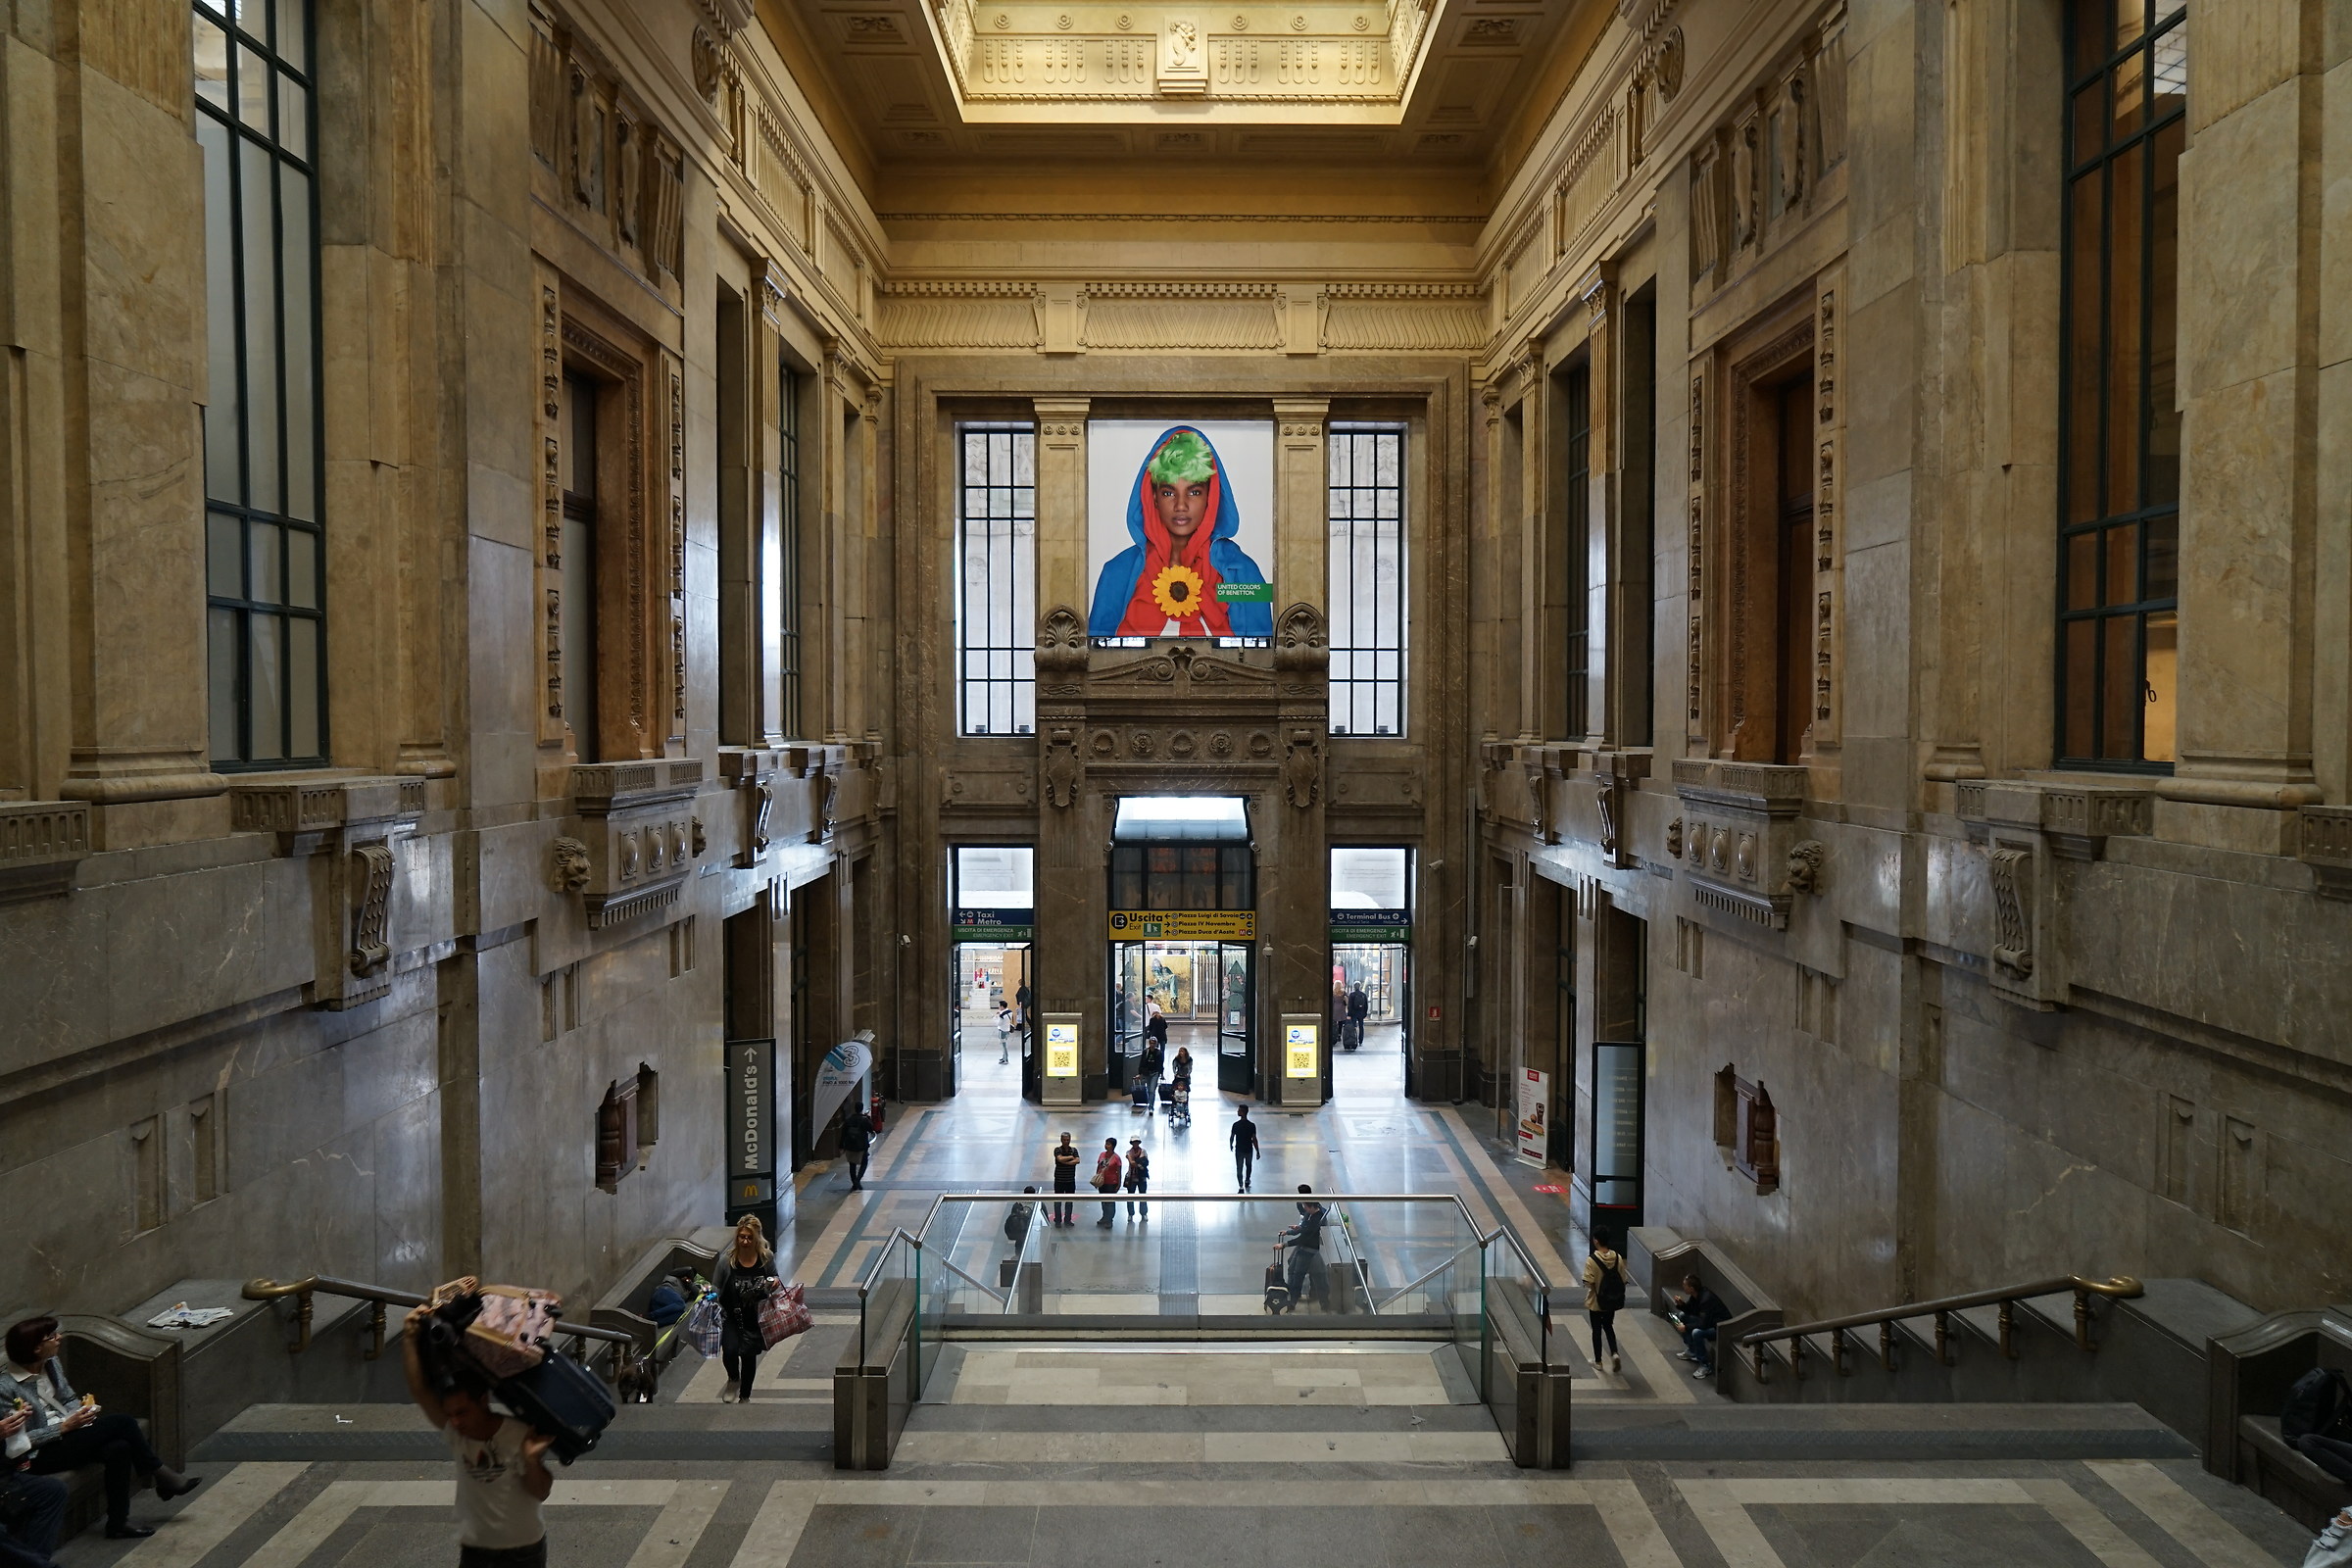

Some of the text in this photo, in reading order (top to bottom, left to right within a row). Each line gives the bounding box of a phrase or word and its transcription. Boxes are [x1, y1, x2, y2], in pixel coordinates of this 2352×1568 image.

[1129, 912, 1163, 922] Uscita
[843, 1045, 860, 1067] 3
[744, 1064, 759, 1170] McDonald's
